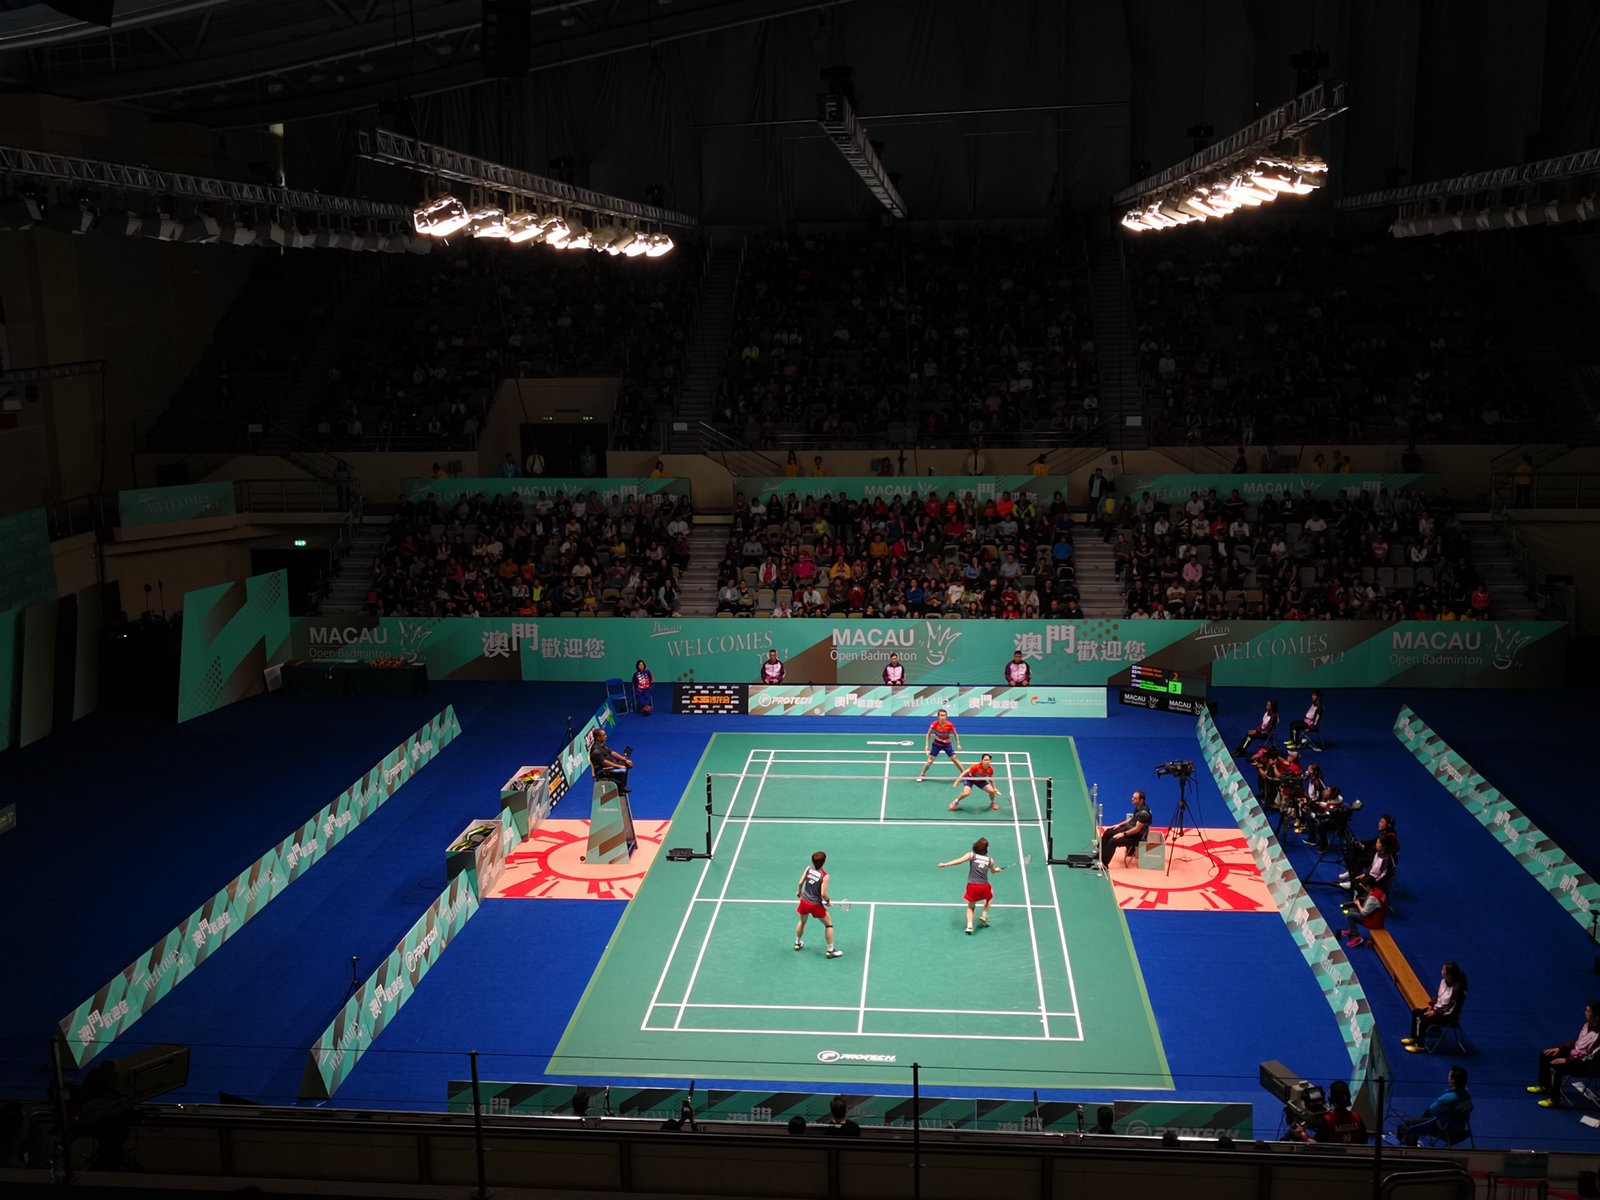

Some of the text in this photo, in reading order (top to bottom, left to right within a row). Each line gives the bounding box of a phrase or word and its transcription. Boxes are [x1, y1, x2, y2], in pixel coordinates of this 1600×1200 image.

[1199, 623, 1231, 635] Macau
[309, 627, 388, 644] MACAU
[481, 623, 605, 658] 澳門歡迎您
[832, 628, 915, 646] MACAU
[1392, 631, 1482, 650] MACAU
[667, 631, 773, 657] WELCOMES
[1213, 633, 1328, 661] WELCOMES
[309, 648, 392, 659] Open Badminton
[830, 650, 858, 662] Open
[1389, 654, 1483, 665] Open Badminton
[771, 696, 813, 705] PROTECH
[1124, 693, 1146, 703] MACAU
[1169, 700, 1192, 709] MACAU
[601, 784, 606, 794] 1
[413, 925, 438, 962] PROTECH
[840, 1053, 897, 1063] PROTECH
